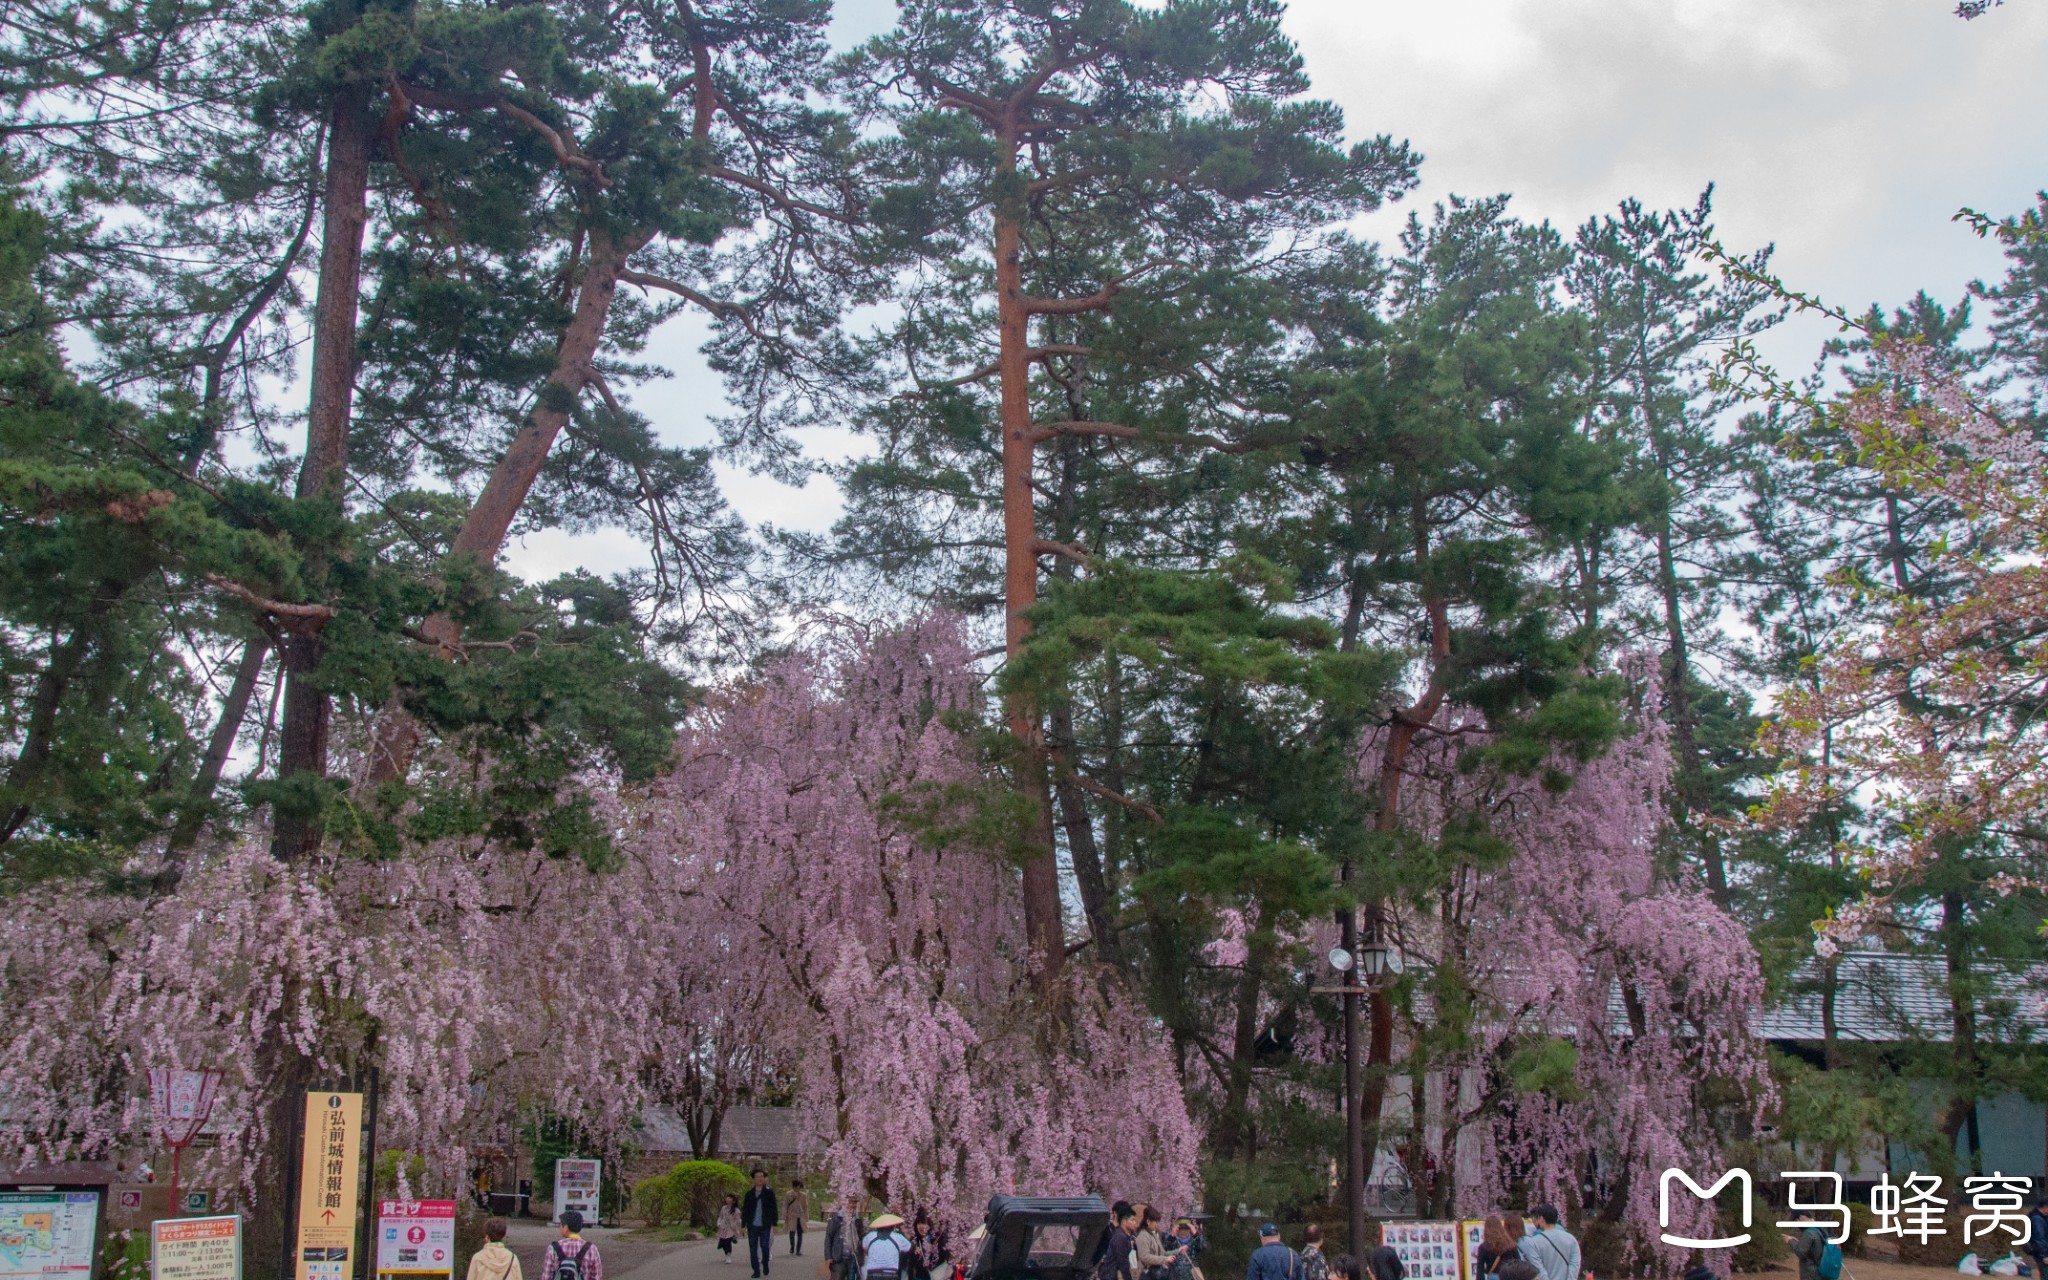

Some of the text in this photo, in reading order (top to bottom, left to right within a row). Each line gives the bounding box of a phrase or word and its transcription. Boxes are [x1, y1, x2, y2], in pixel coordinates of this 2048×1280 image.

[318, 1154, 327, 1188] Information
[325, 1110, 346, 1208] 弘前城情報館
[317, 1187, 325, 1208] Center
[382, 1201, 422, 1216] 貸ゴザ
